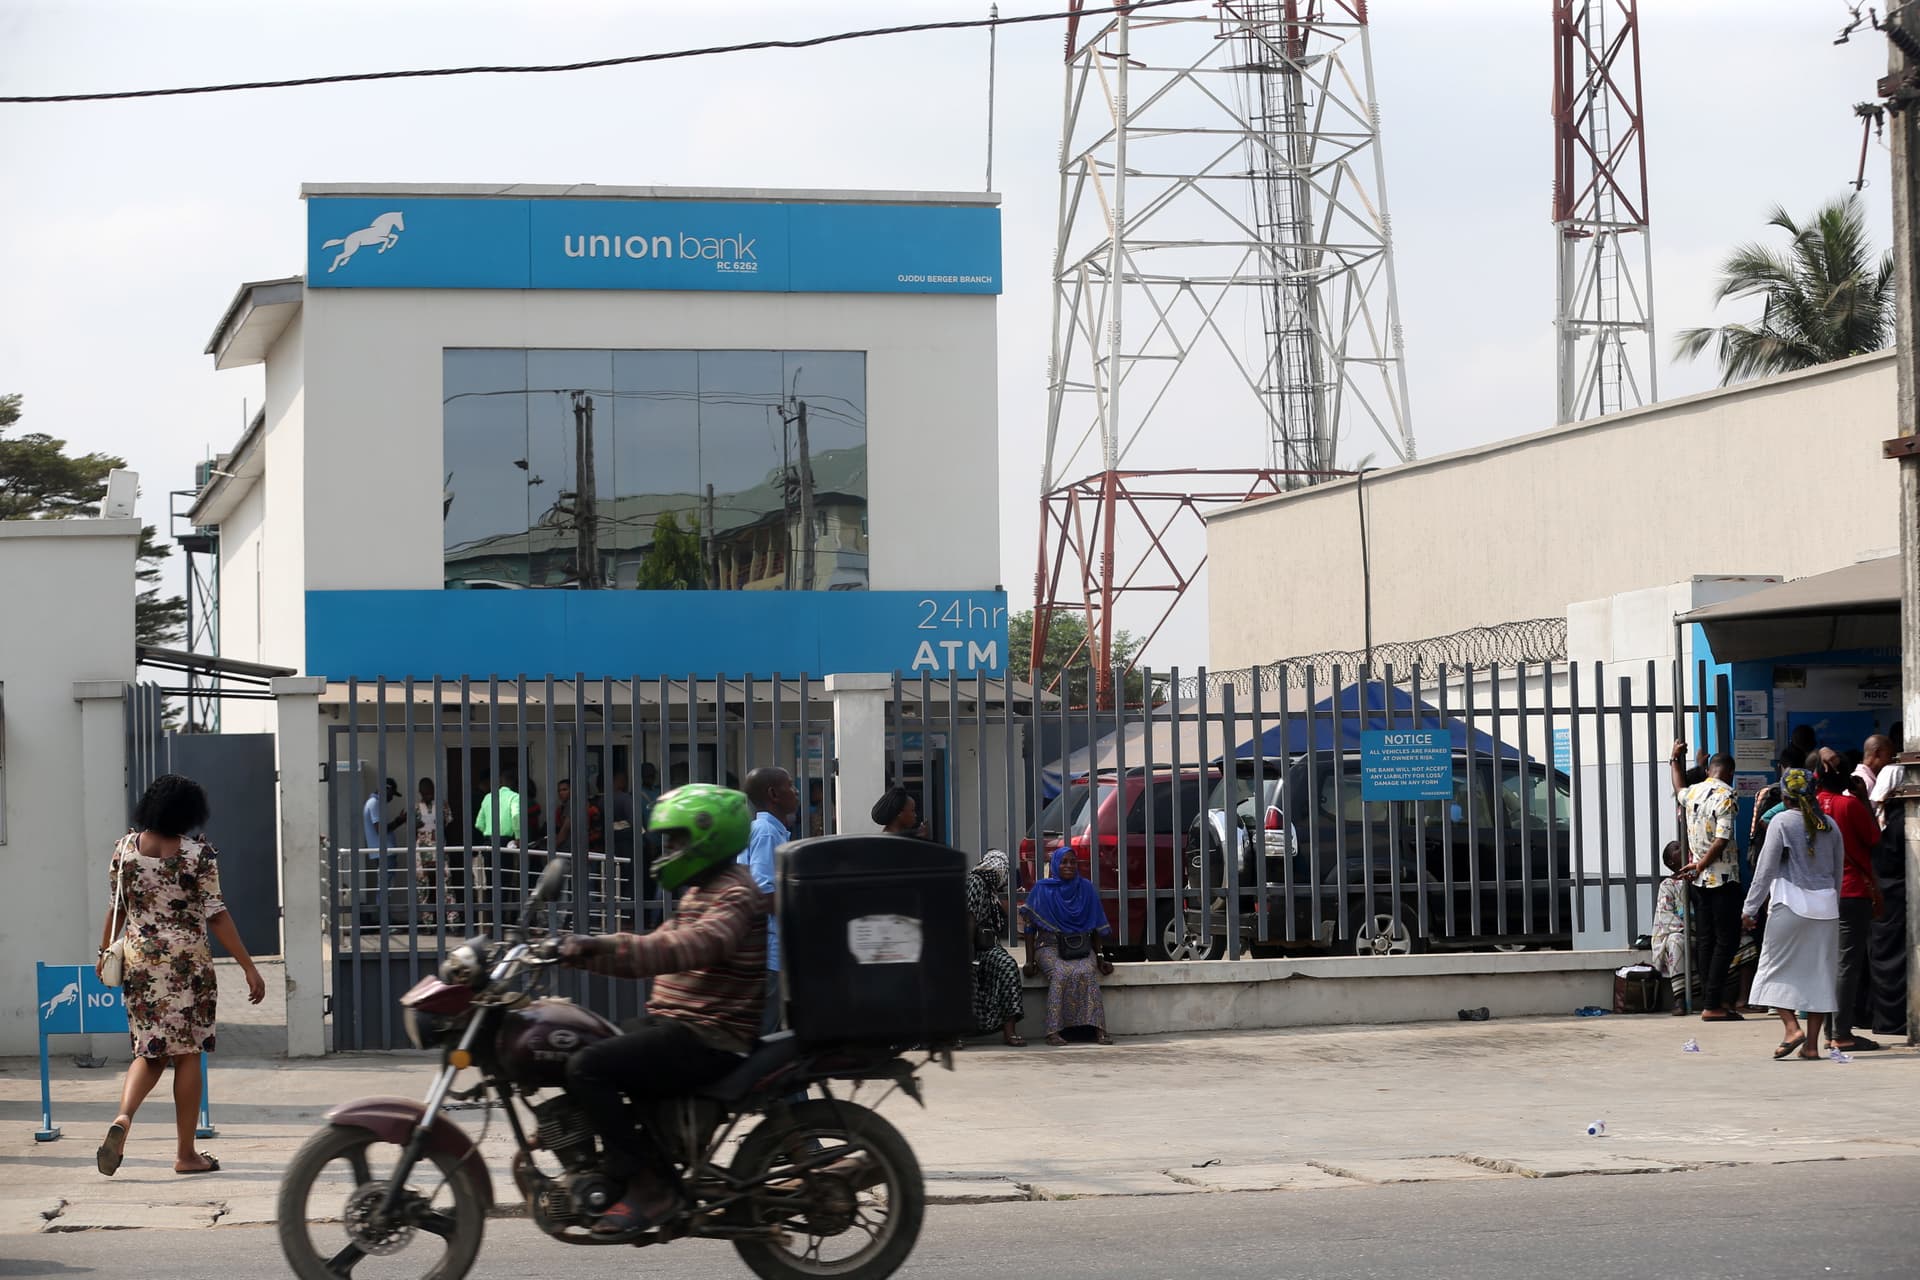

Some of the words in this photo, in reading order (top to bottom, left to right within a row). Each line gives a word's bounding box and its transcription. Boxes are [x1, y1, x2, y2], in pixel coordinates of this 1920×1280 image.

[564, 235, 672, 259] union
[679, 232, 757, 260] bank
[717, 262, 731, 270] RC
[733, 262, 758, 270] 6262
[960, 276, 992, 284] BRANCH
[917, 599, 1004, 629] 24hr
[911, 640, 997, 671] ATM
[1384, 734, 1432, 744] NOTICE
[87, 992, 115, 1008] NO
